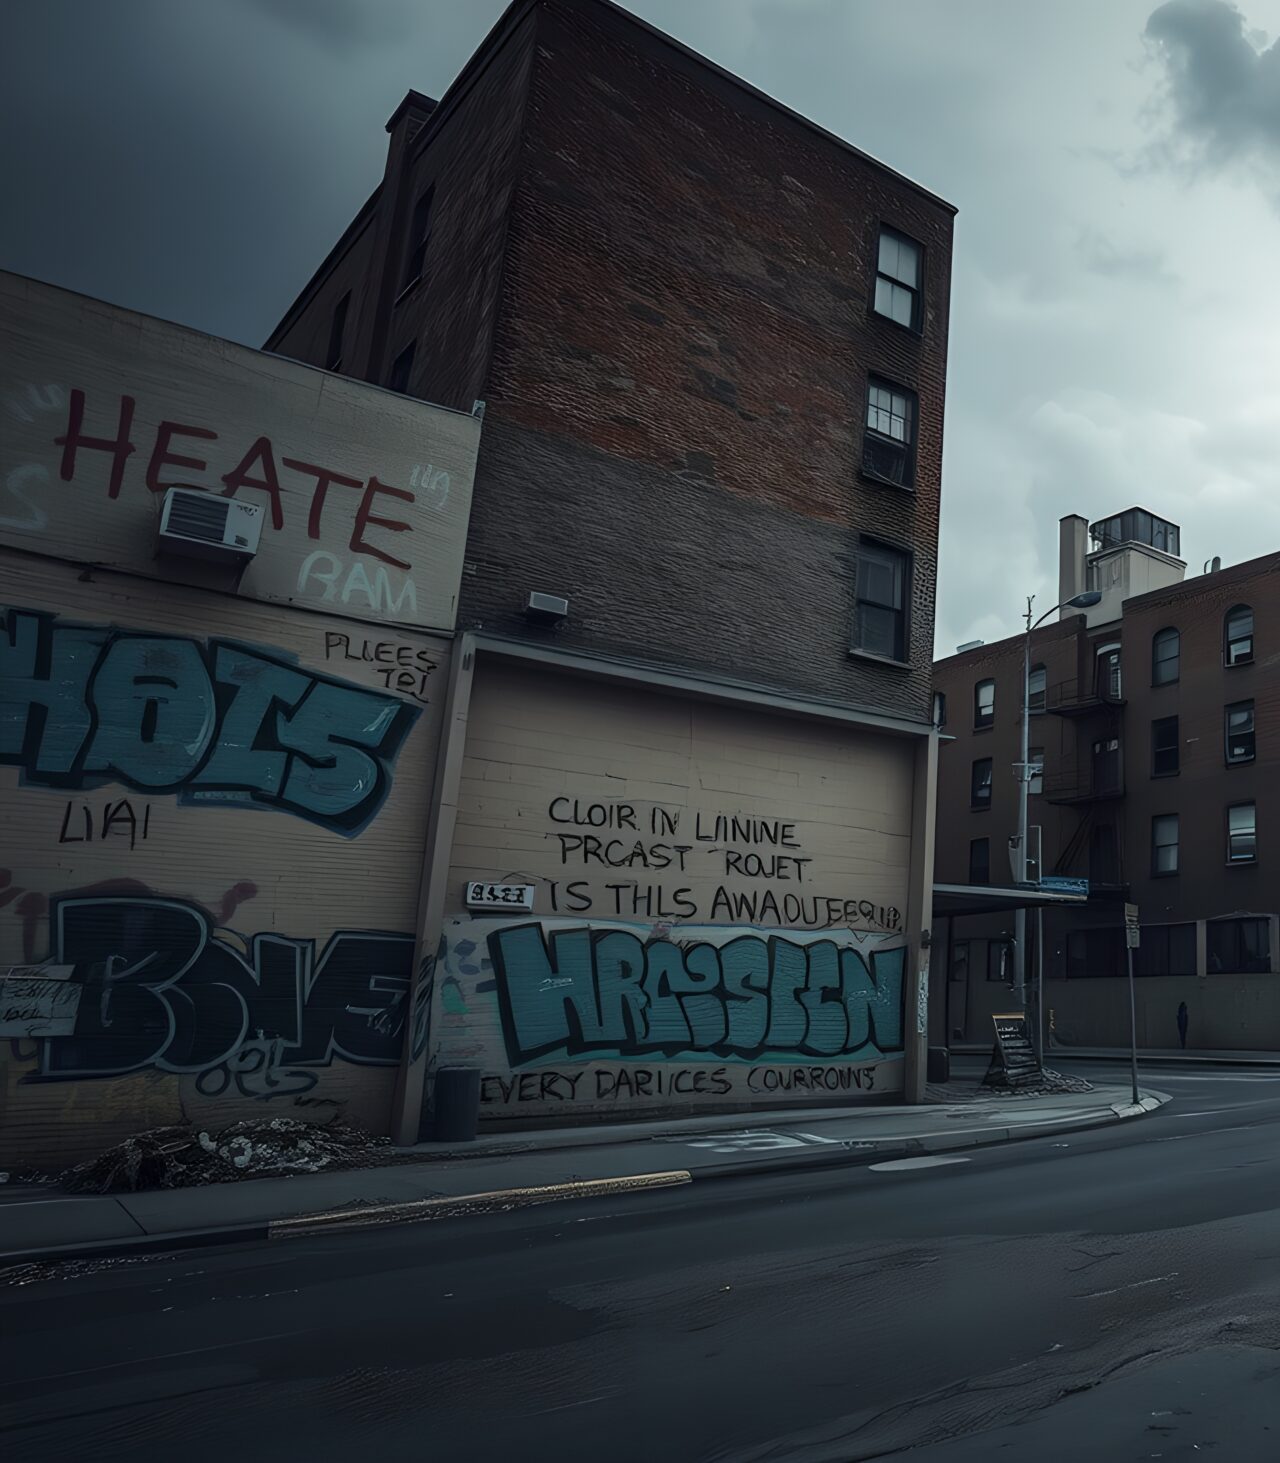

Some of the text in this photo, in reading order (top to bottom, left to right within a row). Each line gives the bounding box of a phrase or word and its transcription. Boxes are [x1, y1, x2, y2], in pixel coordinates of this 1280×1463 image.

[54, 388, 416, 570] HEATE
[550, 881, 592, 911] IS
[480, 1071, 584, 1104] EVERY
